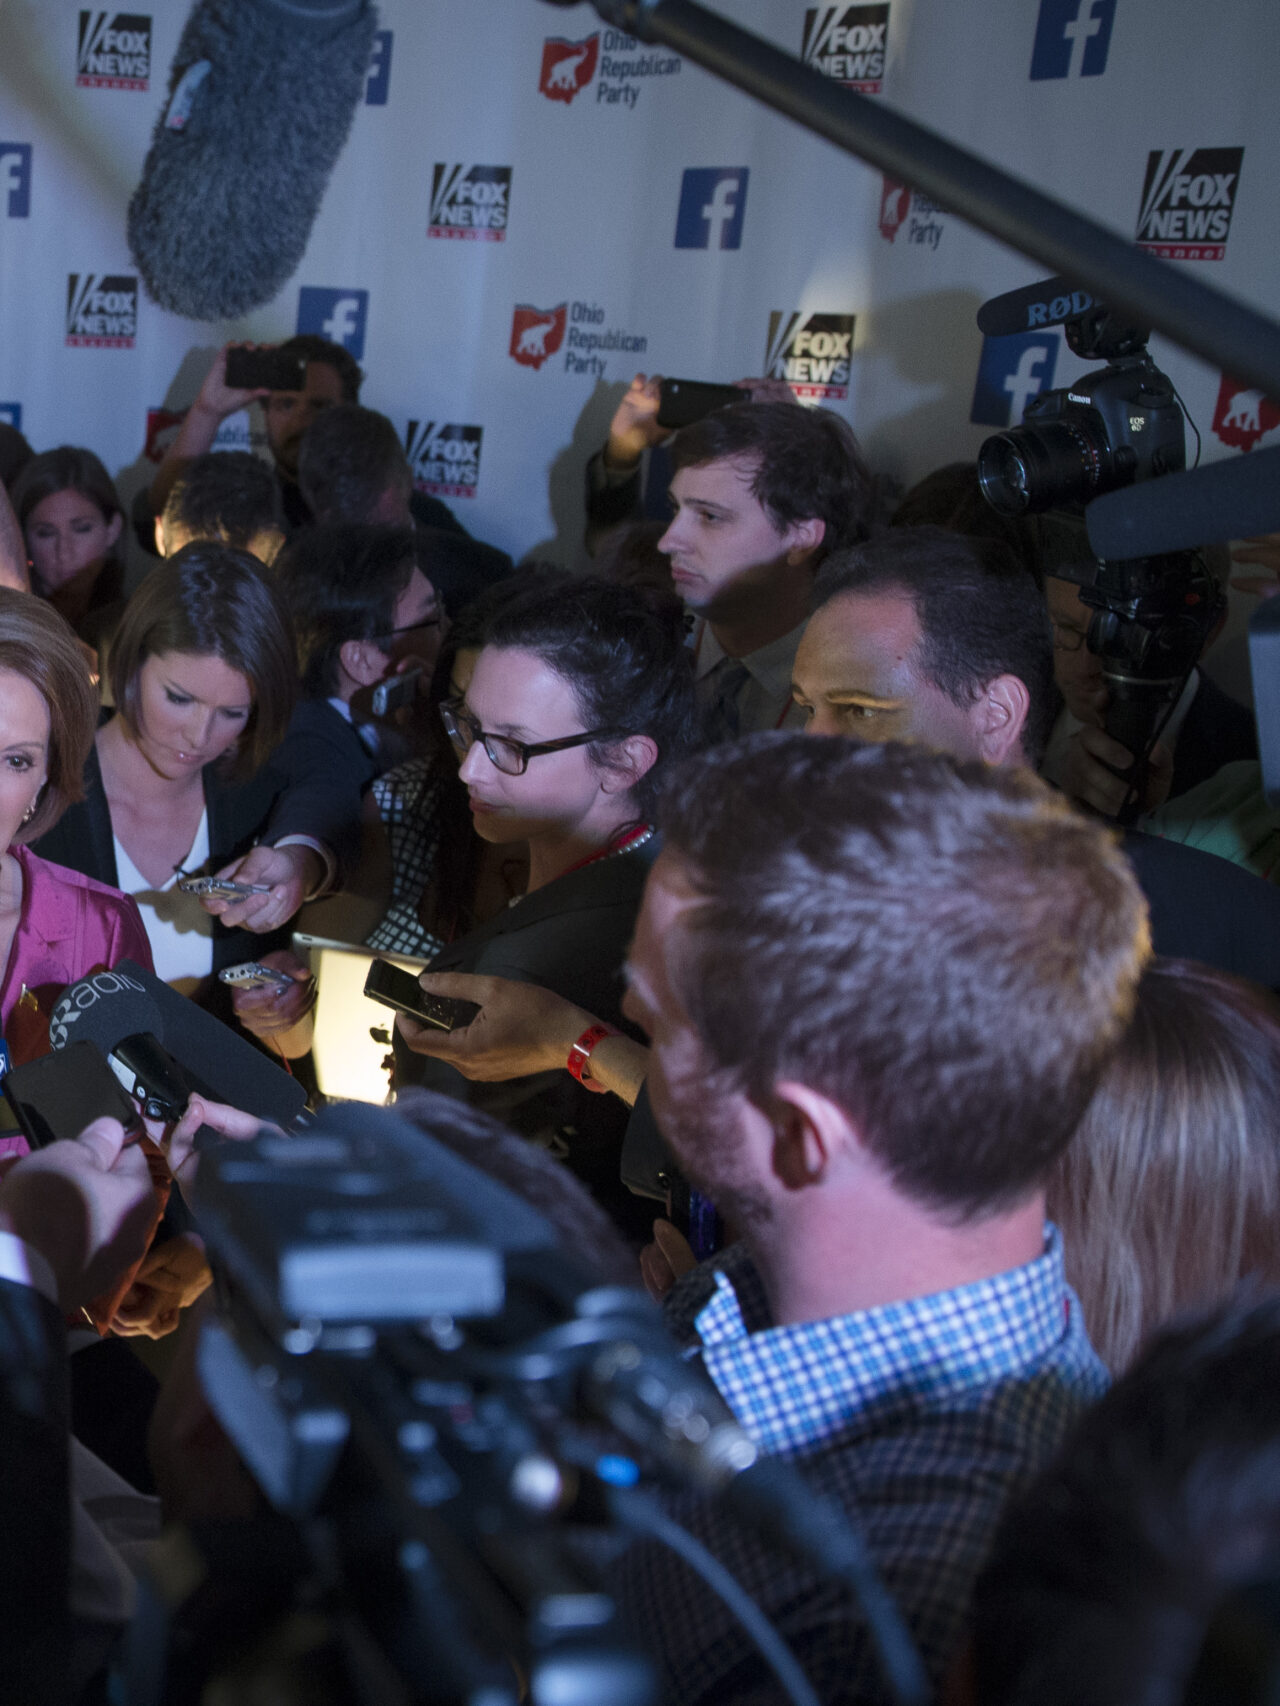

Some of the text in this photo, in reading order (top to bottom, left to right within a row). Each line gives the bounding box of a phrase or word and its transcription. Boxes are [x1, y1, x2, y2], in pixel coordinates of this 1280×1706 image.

[100, 28, 150, 56] FOX
[602, 31, 637, 51] Ohio
[828, 24, 886, 54] FOX
[86, 52, 149, 79] NEWS
[599, 56, 681, 82] Republican
[596, 82, 640, 109] Party
[455, 180, 507, 206] FOX
[1170, 173, 1237, 208] FOX
[438, 204, 505, 230] NEWS
[1148, 208, 1229, 242] NEWS
[909, 217, 944, 250] Party
[1144, 245, 1225, 261] hannel
[88, 290, 138, 316] FOX
[571, 302, 605, 325] Ohio
[1026, 291, 1094, 327] RØD
[77, 314, 136, 337] NEWS
[567, 326, 647, 354] Republican
[793, 330, 852, 358] FOX
[564, 351, 607, 379] Party
[781, 357, 849, 384] NEWS
[1068, 392, 1091, 404] Canon
[1129, 416, 1145, 425] EOS
[428, 438, 480, 464] FOX
[418, 461, 478, 486] NEWS
